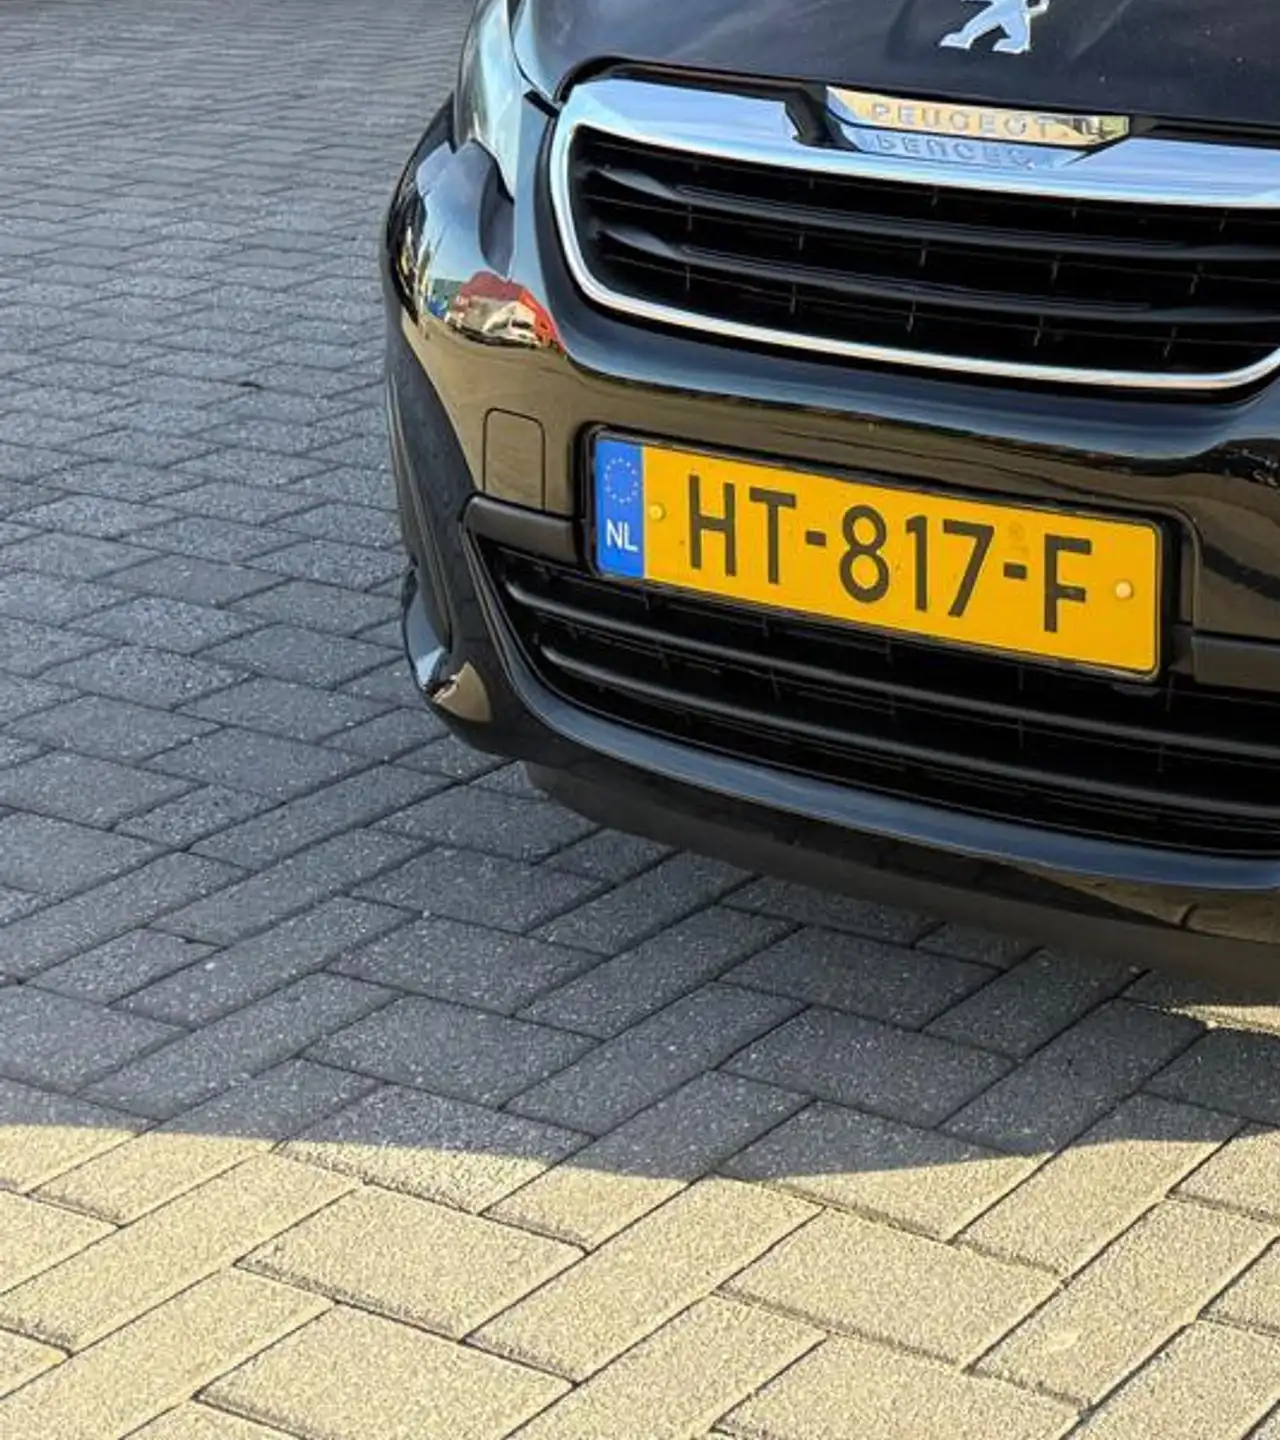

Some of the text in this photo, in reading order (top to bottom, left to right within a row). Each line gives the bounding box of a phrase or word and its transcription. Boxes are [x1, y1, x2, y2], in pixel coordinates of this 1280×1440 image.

[872, 103, 1058, 137] PEUGEOT
[606, 519, 638, 552] NL
[688, 474, 1093, 633] HT-817-F
